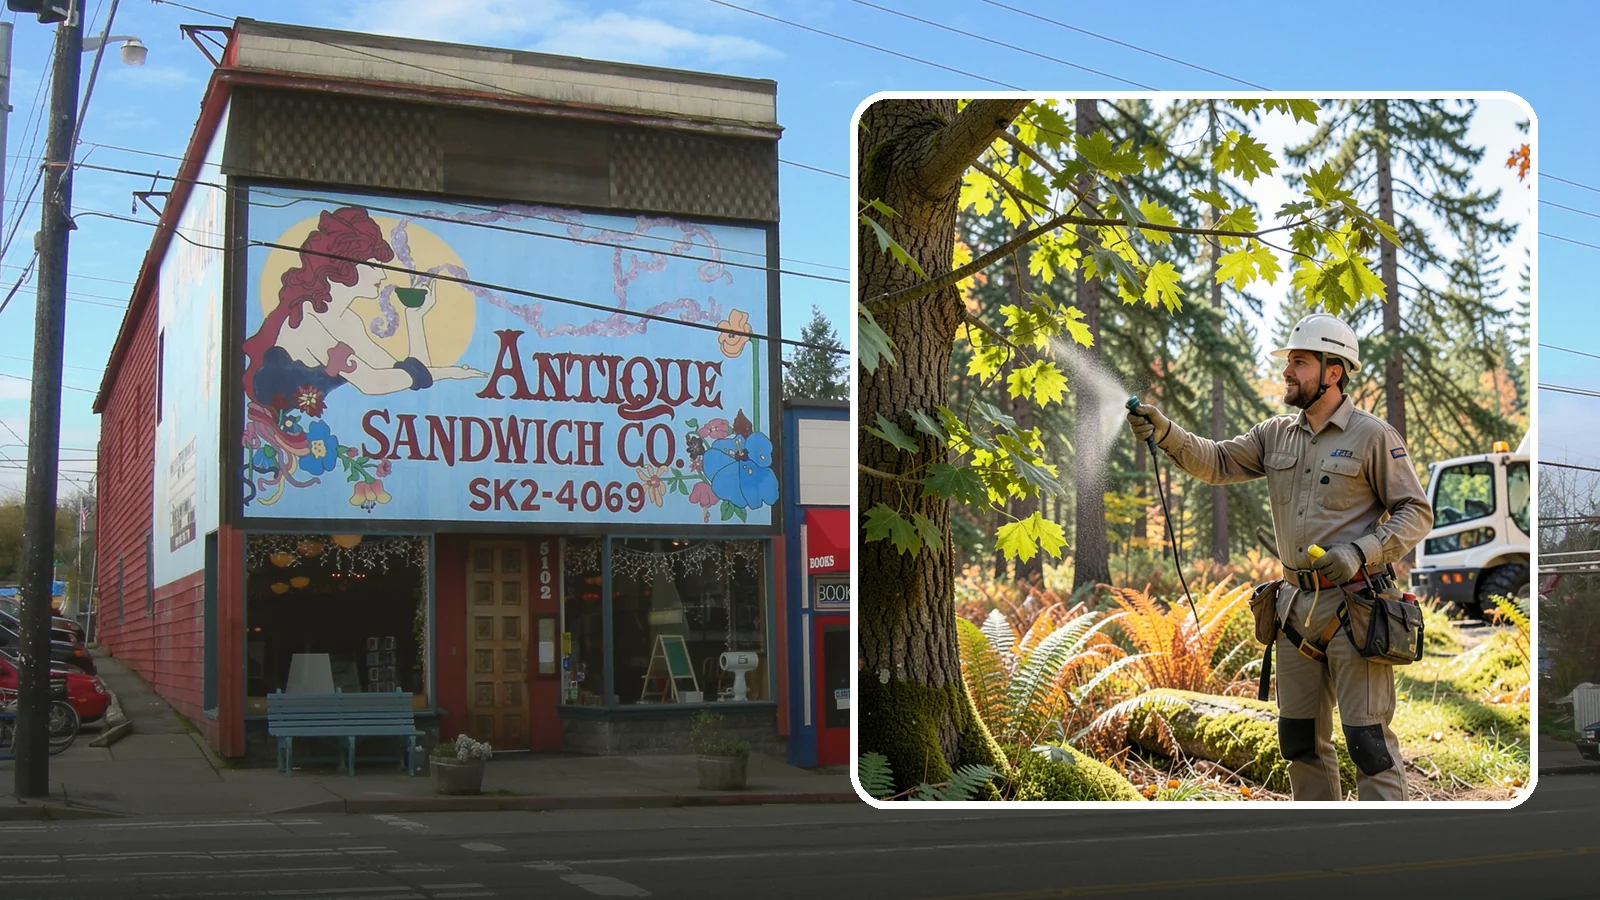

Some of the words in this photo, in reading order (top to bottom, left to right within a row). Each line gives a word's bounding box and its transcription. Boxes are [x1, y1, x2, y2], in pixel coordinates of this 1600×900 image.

[476, 329, 723, 420] ANTIQUE
[361, 408, 604, 467] SANDWICH
[617, 421, 685, 468] CO.
[468, 477, 645, 512] SK2-4069
[540, 541, 551, 600] 5102
[809, 555, 834, 569] BOOKS
